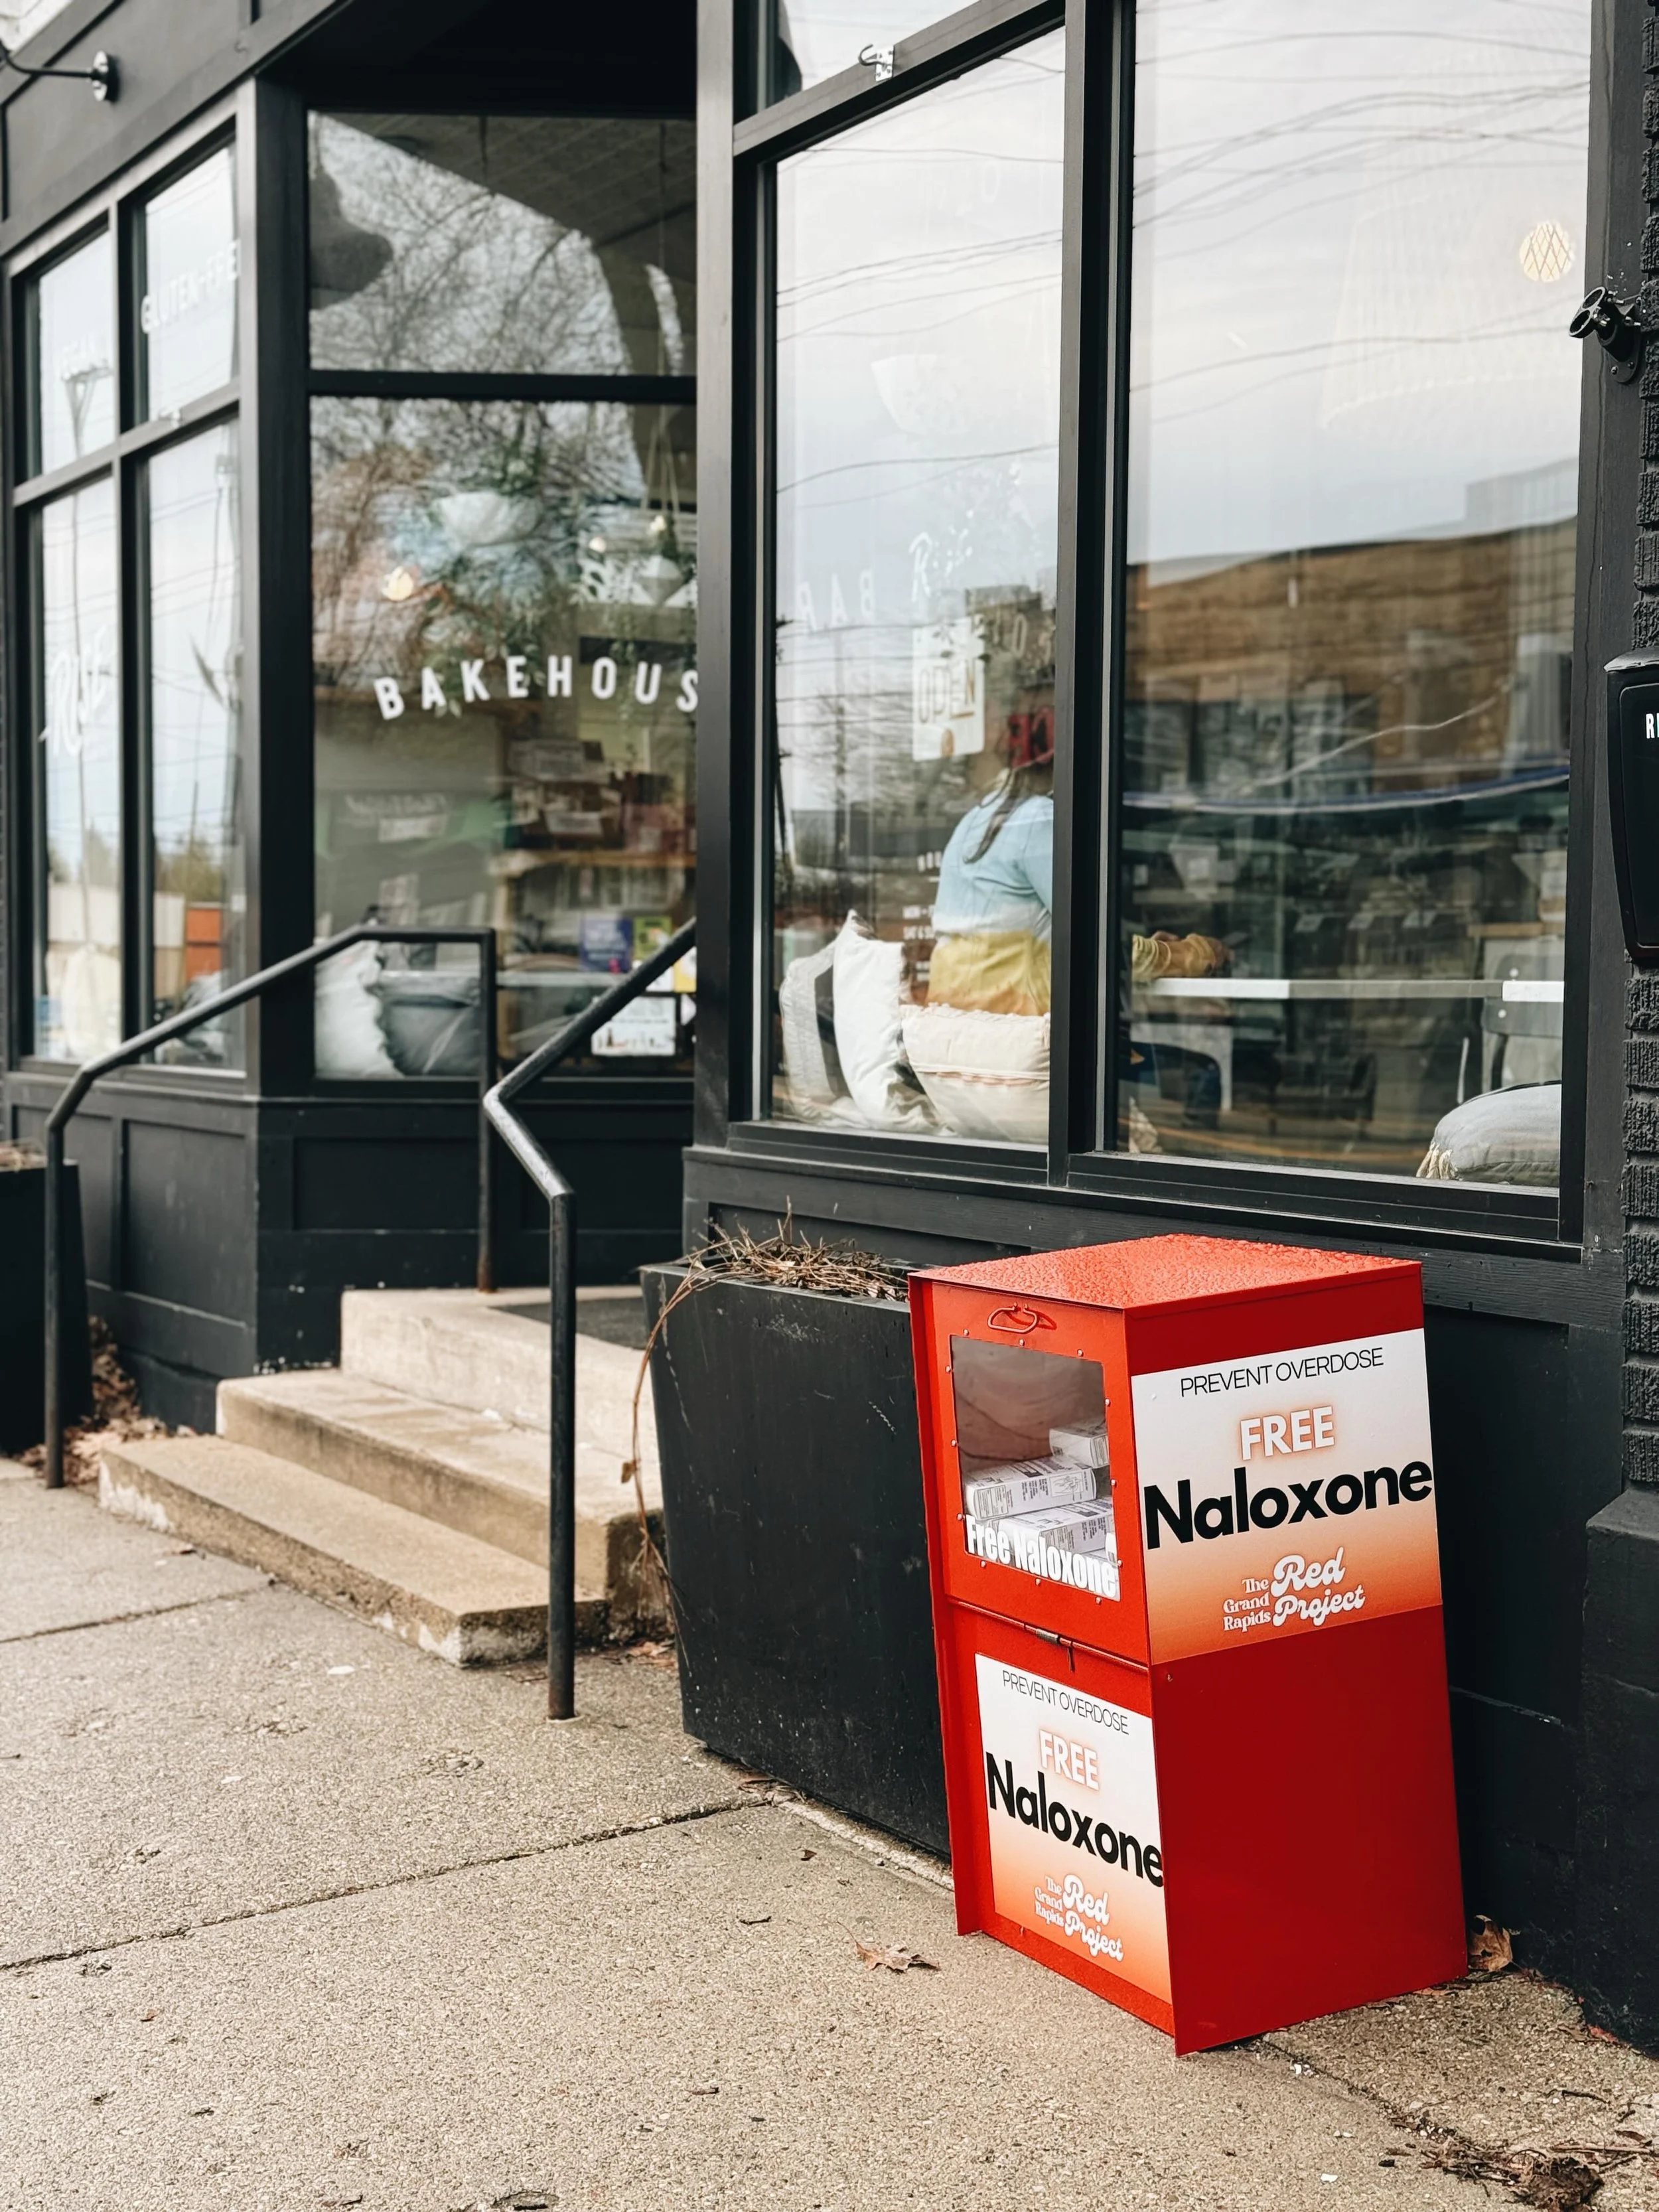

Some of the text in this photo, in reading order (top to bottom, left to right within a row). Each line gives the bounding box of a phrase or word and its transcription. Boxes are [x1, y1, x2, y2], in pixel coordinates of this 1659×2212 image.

[1181, 1347, 1384, 1398] PREVENT OVERDOSE
[1240, 1406, 1335, 1461] FREE
[1143, 1461, 1433, 1550] Naloxone
[966, 1514, 1116, 1597] Free Naloxone
[1271, 1546, 1346, 1597] Red
[1223, 1593, 1270, 1614] Grand
[1242, 1577, 1269, 1594] The
[1271, 1584, 1366, 1626] Project
[1223, 1609, 1271, 1632] Rapids
[1002, 1670, 1129, 1735] PREVENT OVERDOSE
[1038, 1729, 1100, 1791] FREE
[985, 1751, 1164, 1888] Naloxone
[1034, 1885, 1063, 1911] Grand
[1044, 1876, 1062, 1894] The
[1062, 1874, 1109, 1925] Red
[1034, 1899, 1064, 1927] Rapids
[1064, 1910, 1123, 1961] Project
